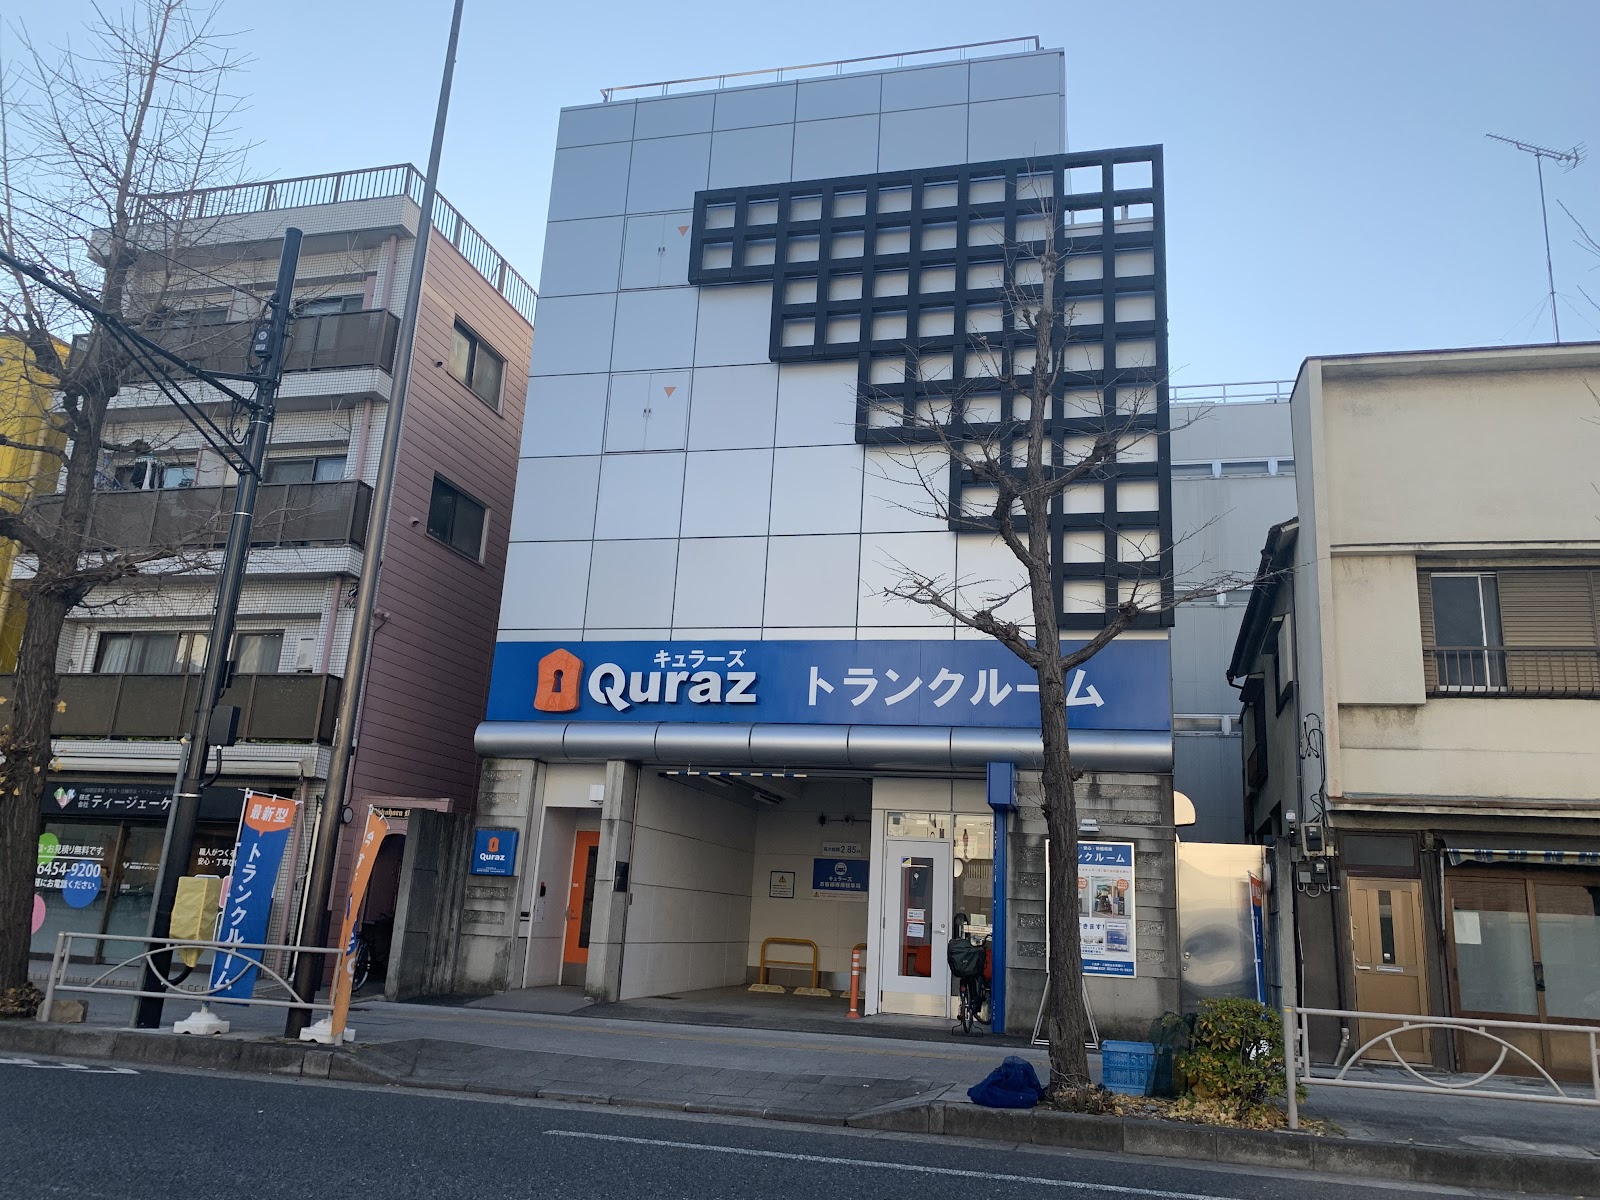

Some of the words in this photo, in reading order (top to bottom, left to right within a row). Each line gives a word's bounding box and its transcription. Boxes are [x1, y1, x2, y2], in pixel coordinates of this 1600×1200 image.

[653, 648, 747, 669] キュラーズ
[588, 662, 757, 712] Quraz
[808, 666, 1105, 708] トランクルーム
[250, 803, 290, 824] 最新型
[479, 852, 506, 862] Quraz
[213, 842, 262, 991] トランクルーム
